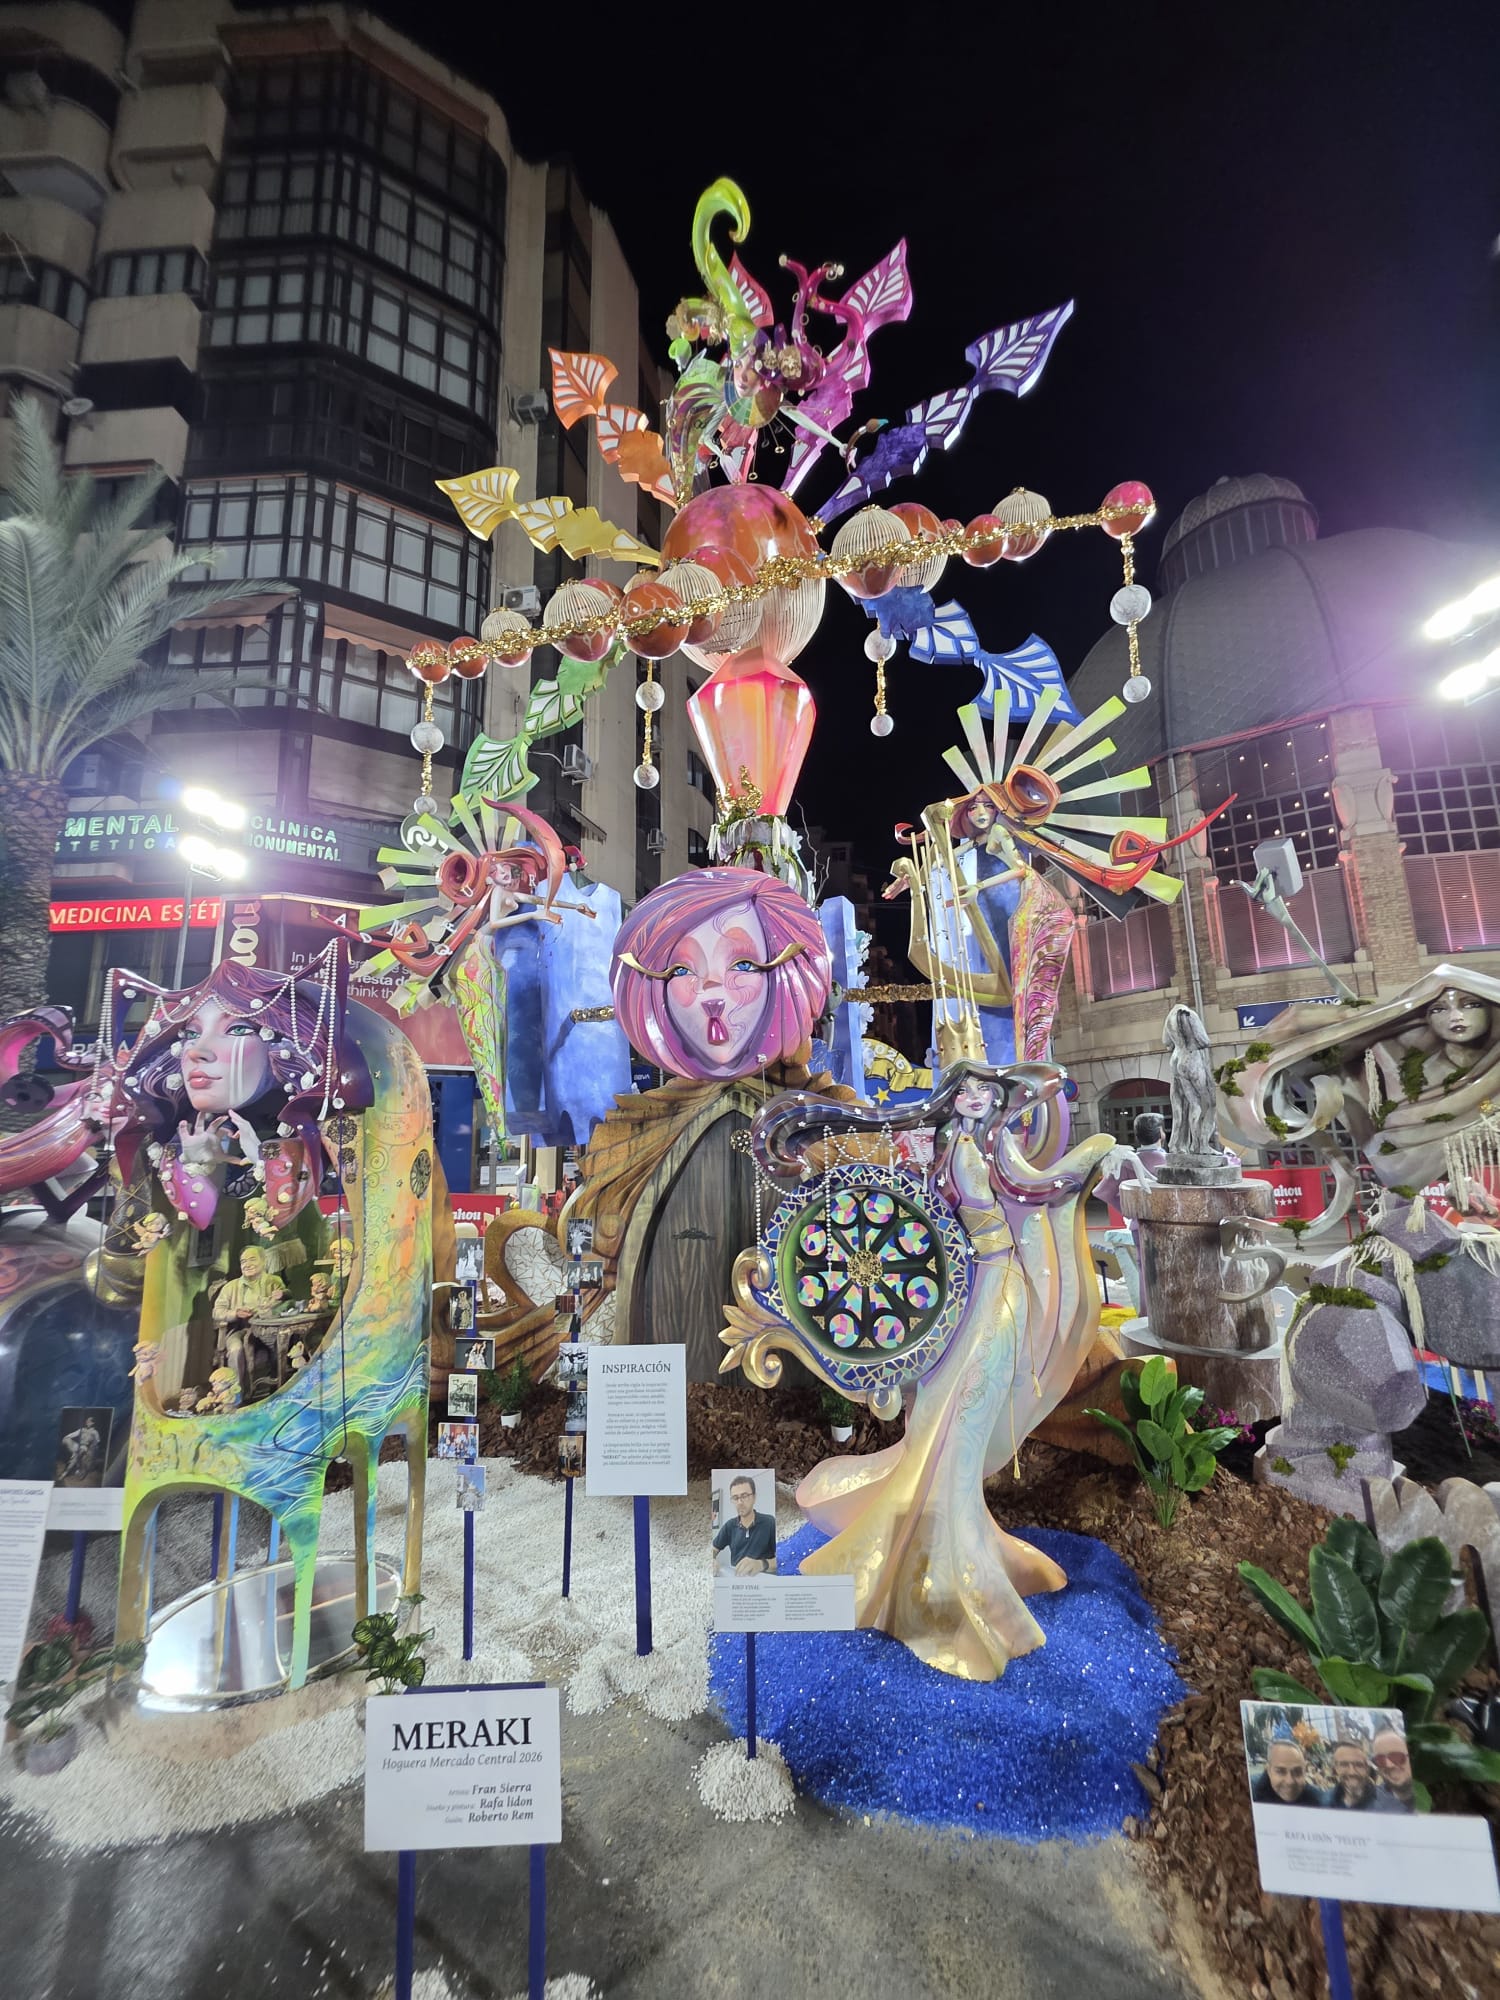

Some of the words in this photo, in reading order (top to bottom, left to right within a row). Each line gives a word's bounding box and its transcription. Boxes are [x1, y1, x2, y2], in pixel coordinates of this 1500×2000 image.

[57, 814, 180, 837] MENTAL
[251, 816, 337, 843] CLINICA
[50, 906, 152, 925] MEDICINA
[1273, 1185, 1303, 1197] ahou
[602, 1360, 671, 1374] INSPIRACIÓN
[391, 1716, 533, 1751] MERAKI
[382, 1757, 427, 1773] Hoguera
[429, 1753, 475, 1768] Mercado
[477, 1751, 517, 1765] Central
[518, 1751, 543, 1764] 2026
[472, 1783, 497, 1795] Fran
[499, 1781, 532, 1794] Sierra
[480, 1796, 504, 1810] Rafa
[468, 1810, 509, 1823] Roberto
[511, 1809, 534, 1821] Rem
